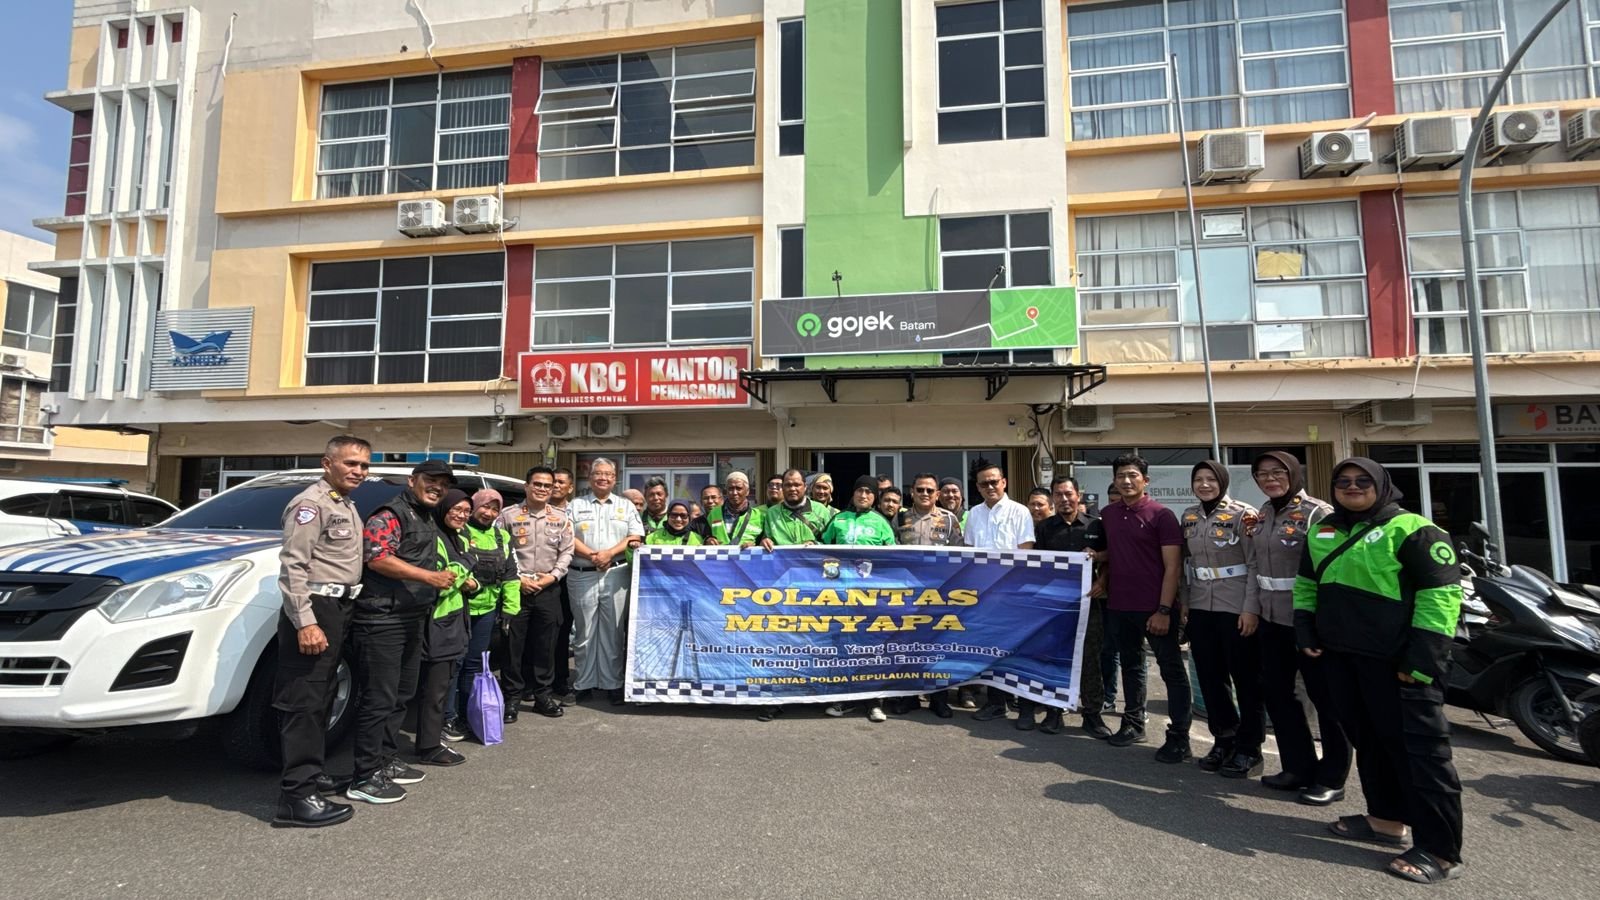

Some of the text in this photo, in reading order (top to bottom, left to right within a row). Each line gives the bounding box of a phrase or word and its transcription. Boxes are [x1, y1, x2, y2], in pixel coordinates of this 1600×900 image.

[827, 311, 936, 338] gojek Batam
[570, 361, 627, 394] KBC
[650, 356, 738, 382] KANTOR
[533, 395, 627, 404] KING BUSINESS CENTRE
[650, 383, 737, 401] PEMASARAN
[1555, 404, 1600, 425] BA
[1150, 487, 1175, 497] SENTRA
[719, 588, 979, 606] POLANTAS
[724, 614, 966, 632] MENYAPA
[685, 642, 1014, 658] "Lalu Lintas Modern Yang Berkeselamata
[751, 655, 945, 670] Menuju Indonesia Emas"
[745, 672, 951, 685] DITLANTAS POLDA KEPULAUAN RIAU
